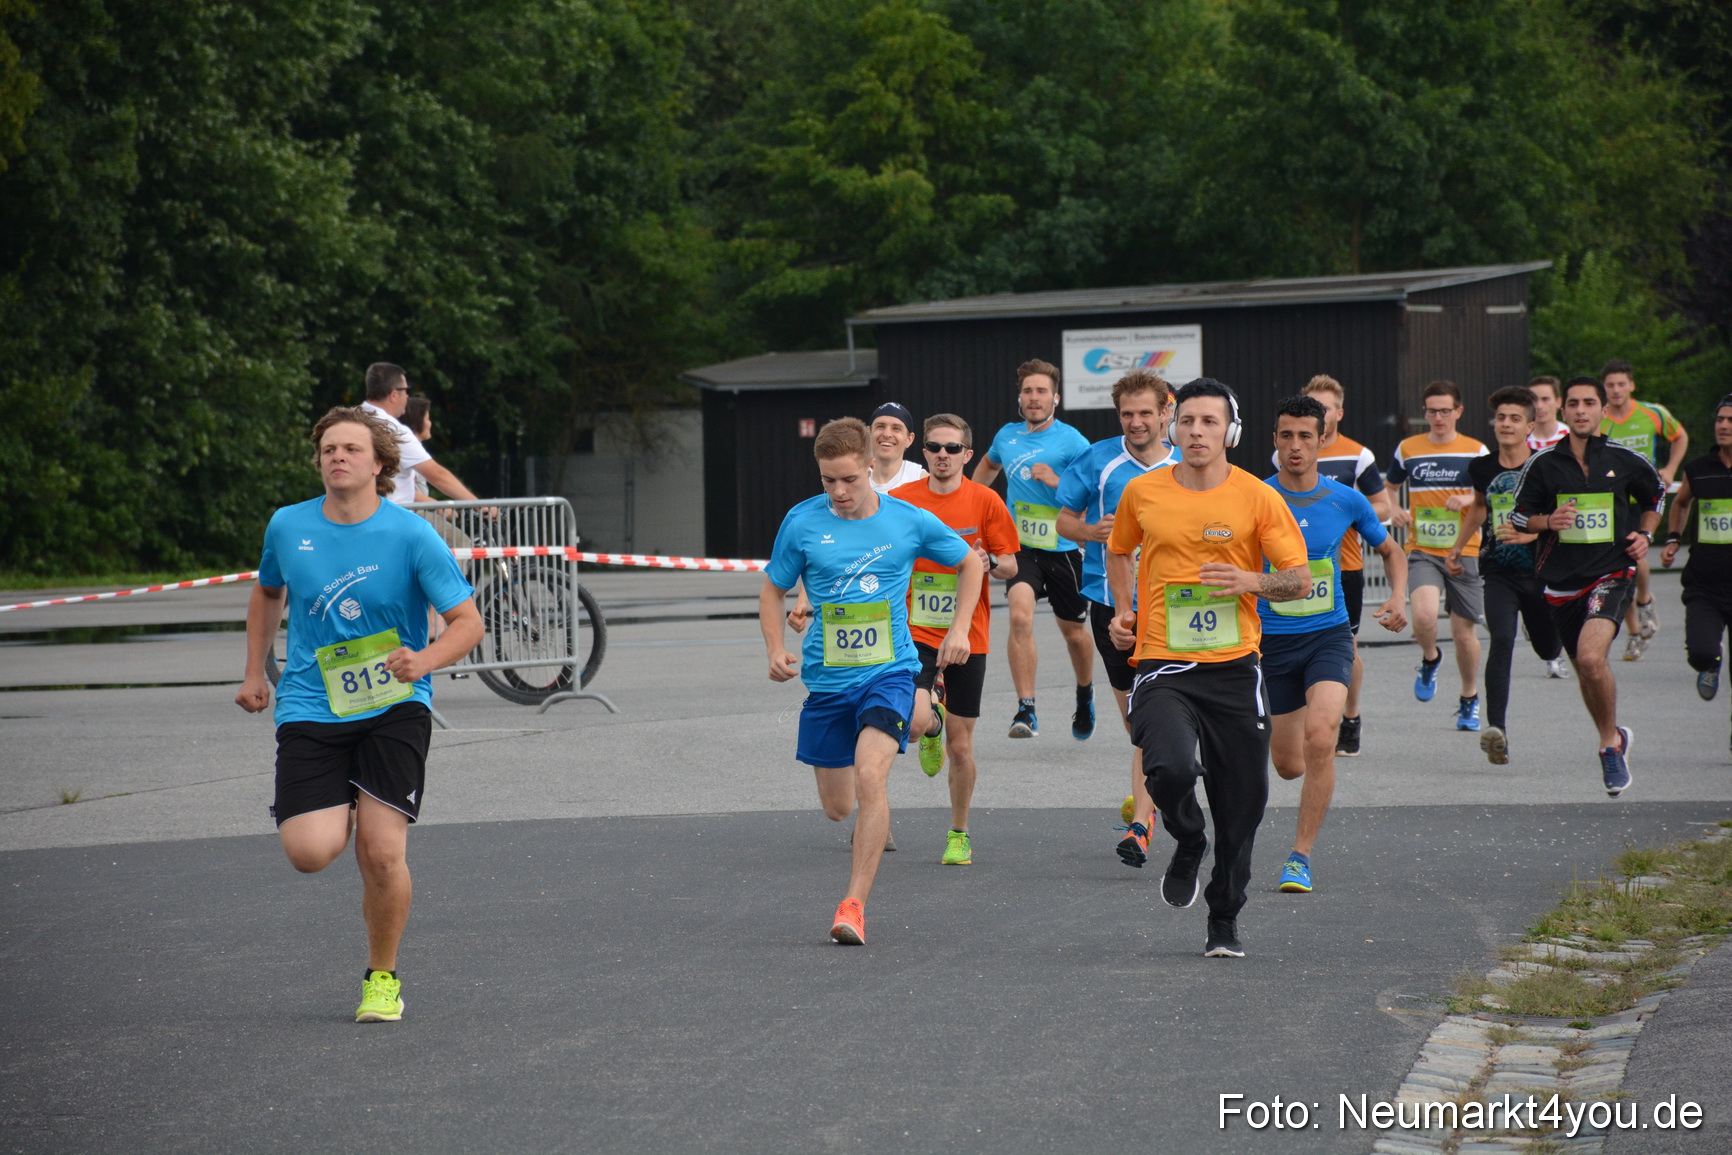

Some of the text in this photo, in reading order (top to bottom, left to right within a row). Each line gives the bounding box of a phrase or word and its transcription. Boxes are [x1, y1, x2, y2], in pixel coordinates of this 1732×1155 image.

[1420, 467, 1460, 478] Fischer
[1021, 519, 1048, 537] 810
[1420, 523, 1456, 536] 1623
[1573, 513, 1608, 530] 653
[1704, 516, 1732, 531] 166
[829, 543, 893, 595] Team Schick Bau
[309, 564, 379, 616] Team Schick Bau
[1189, 610, 1217, 632] 49
[836, 627, 877, 649] 820
[341, 662, 391, 694] 813
